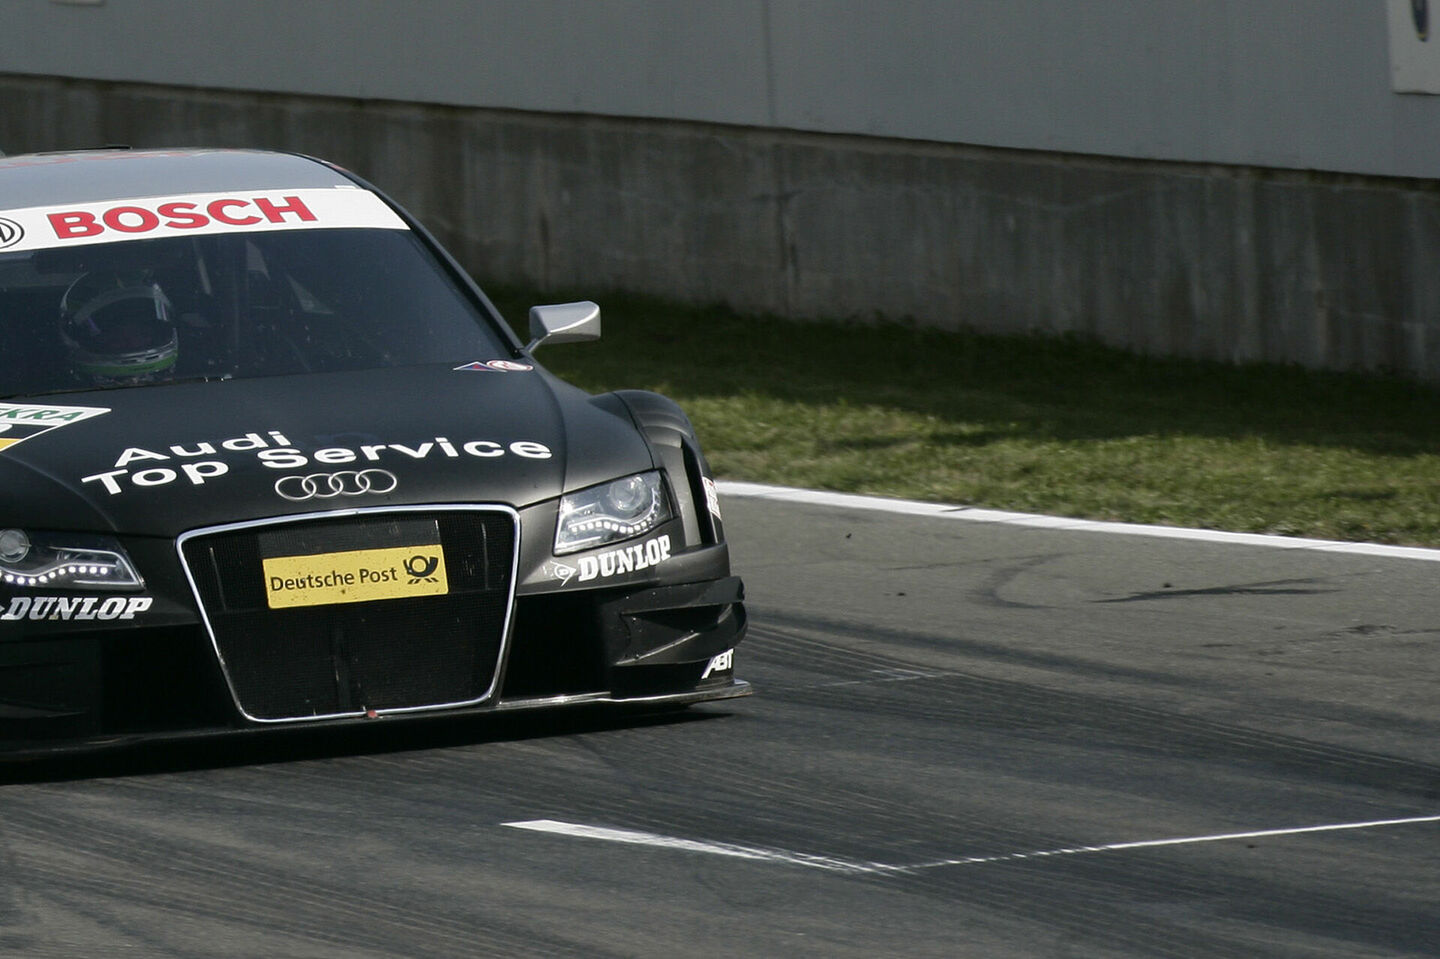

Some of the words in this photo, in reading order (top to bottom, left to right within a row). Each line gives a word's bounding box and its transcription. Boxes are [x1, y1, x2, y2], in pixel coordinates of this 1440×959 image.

[46, 195, 318, 239] BOSCH
[81, 460, 229, 495] Top
[259, 436, 553, 469] Service
[113, 430, 292, 467] Audi
[577, 535, 672, 582] DUNLOP
[270, 570, 355, 591] Deutsche
[359, 567, 398, 583] Post
[0, 597, 153, 620] DUNLOP
[701, 648, 734, 679] ABT
